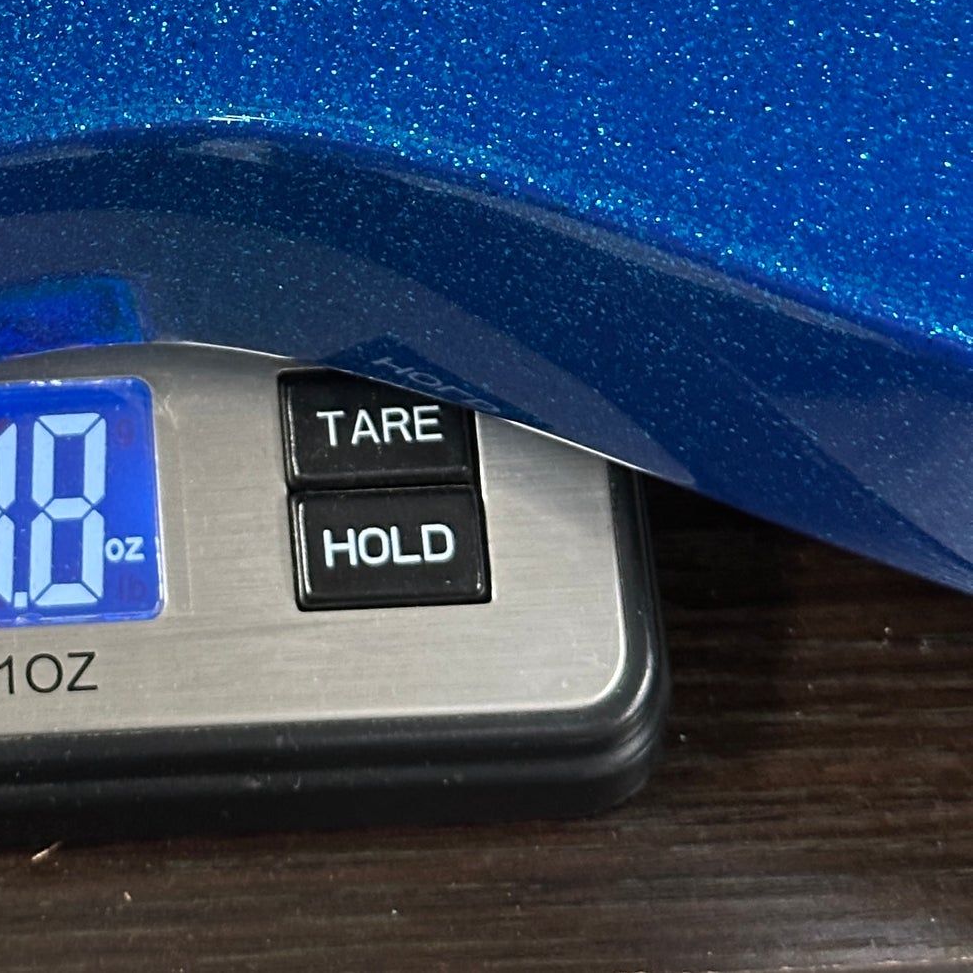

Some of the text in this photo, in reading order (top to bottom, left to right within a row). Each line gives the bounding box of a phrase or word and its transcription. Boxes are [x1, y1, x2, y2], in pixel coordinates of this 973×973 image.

[316, 404, 444, 447] TARE
[105, 536, 146, 563] oz
[323, 523, 455, 568] HOLD
